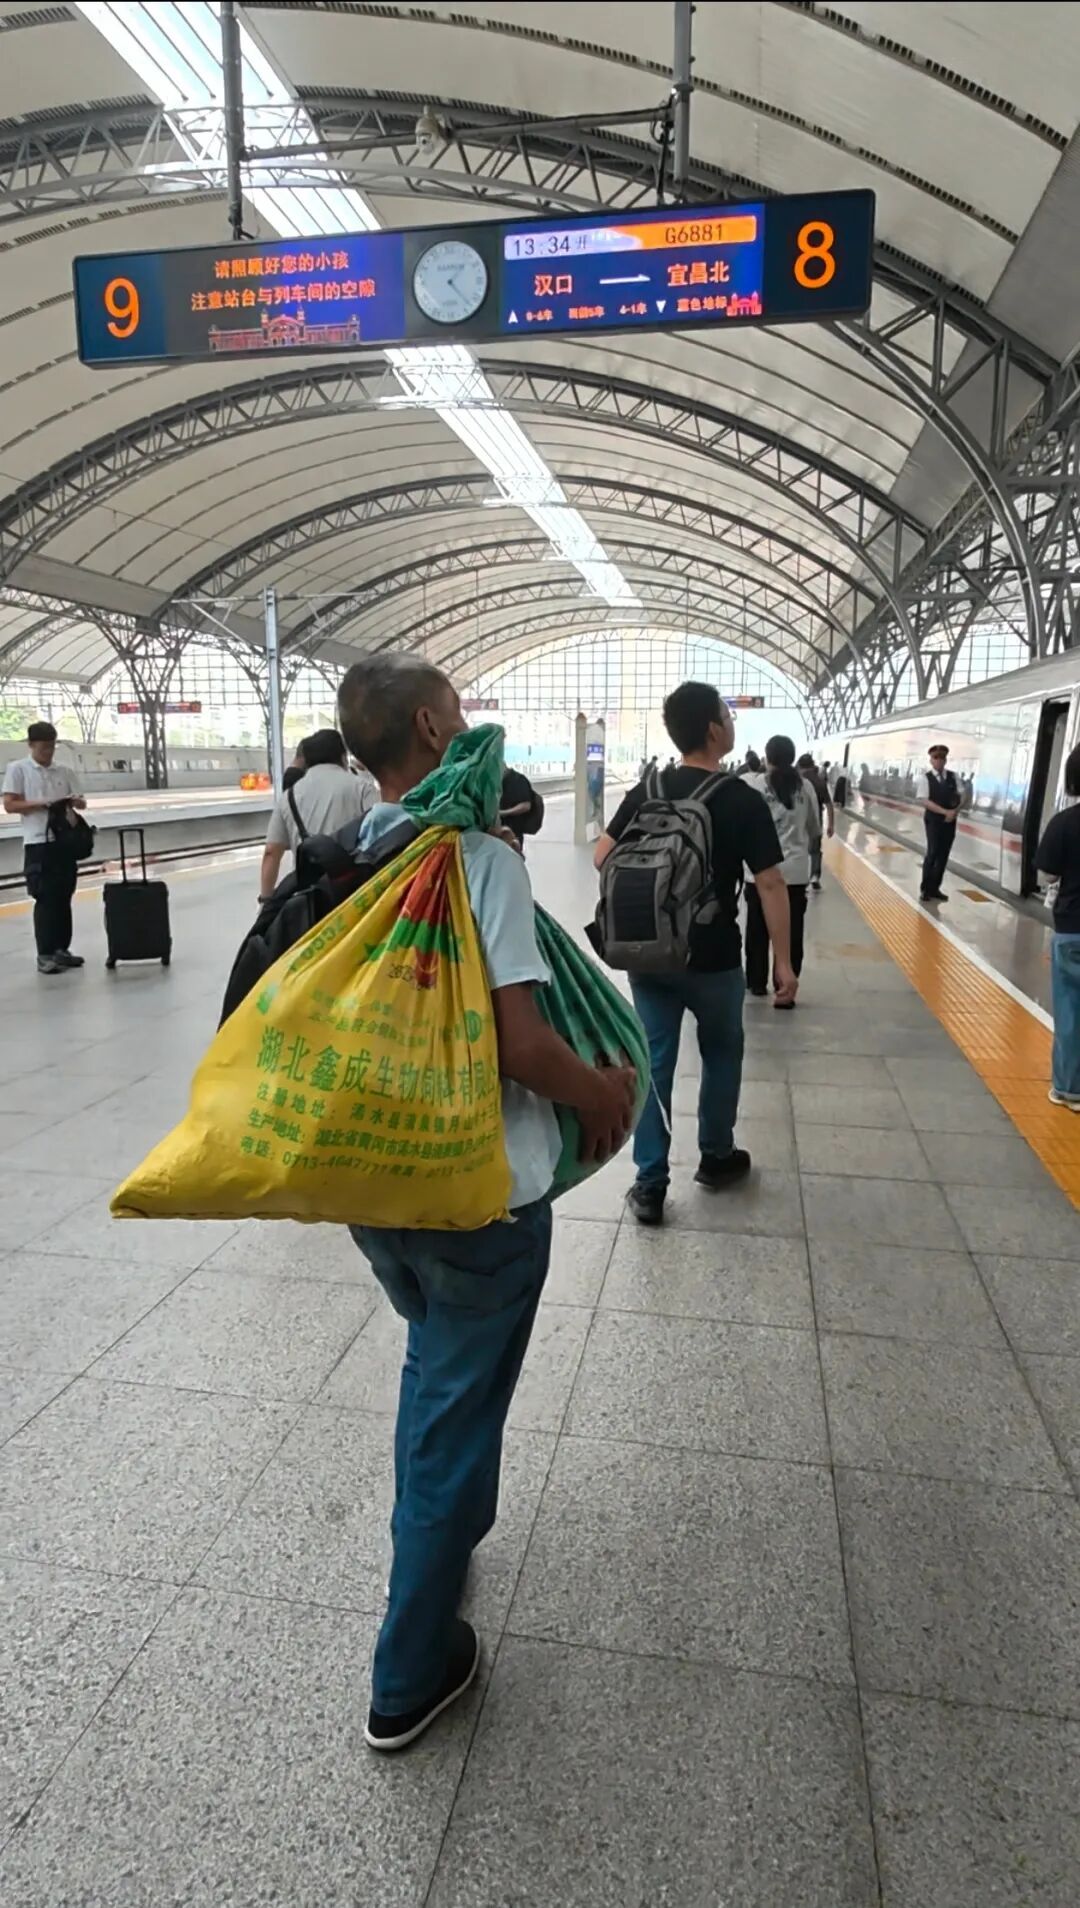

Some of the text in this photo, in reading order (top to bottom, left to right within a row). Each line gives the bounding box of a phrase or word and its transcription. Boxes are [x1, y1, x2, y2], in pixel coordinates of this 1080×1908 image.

[665, 223, 724, 244] G6881
[214, 250, 350, 280] 请照顾好您的小孩
[795, 220, 836, 290] 8
[190, 278, 377, 312] 注意站台与列车间的空隙
[534, 260, 730, 297] 汉口 宜昌北
[103, 276, 141, 339] 9
